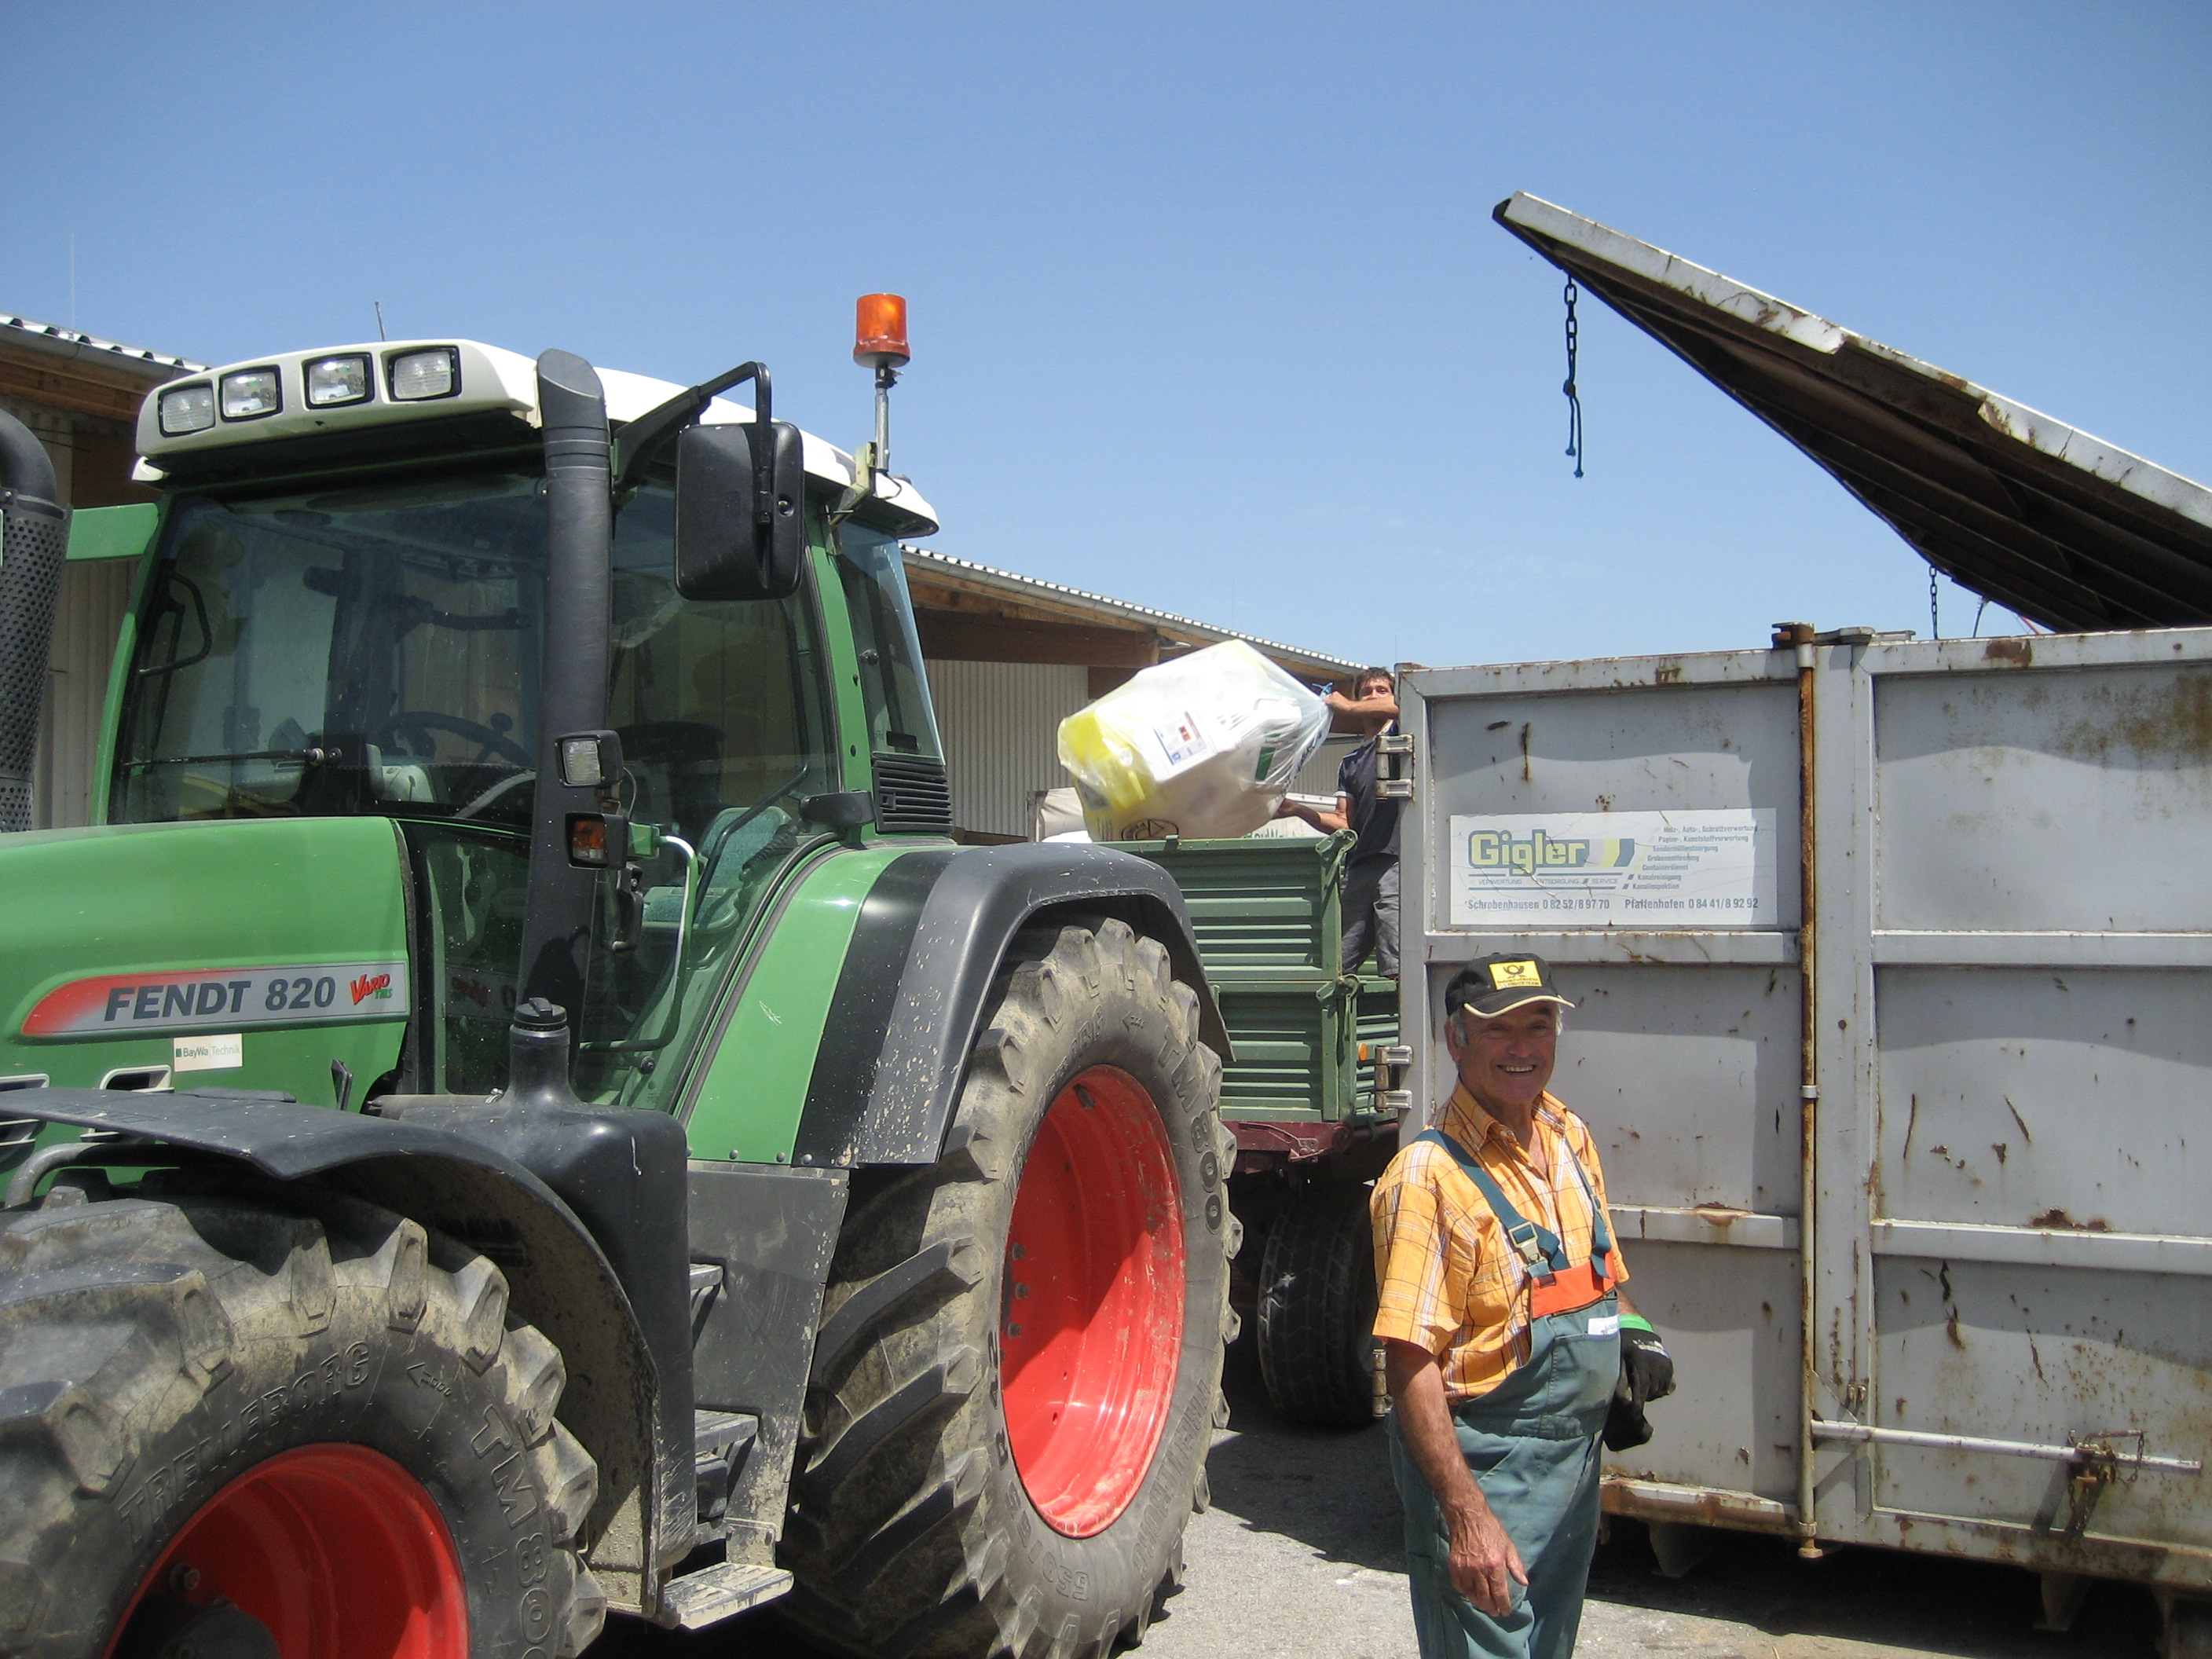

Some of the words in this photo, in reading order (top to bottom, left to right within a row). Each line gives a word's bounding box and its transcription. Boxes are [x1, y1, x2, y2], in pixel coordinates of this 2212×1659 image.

[1469, 830, 1588, 876] Gigler
[1467, 899, 1540, 910] Schrobenhausen
[1624, 898, 1685, 910] Pfaffenhofen
[104, 980, 252, 1022] FENDT
[265, 976, 336, 1011] 820
[350, 974, 390, 1005] VARIO
[182, 1046, 209, 1059] BayWa
[211, 1044, 241, 1056] Technik
